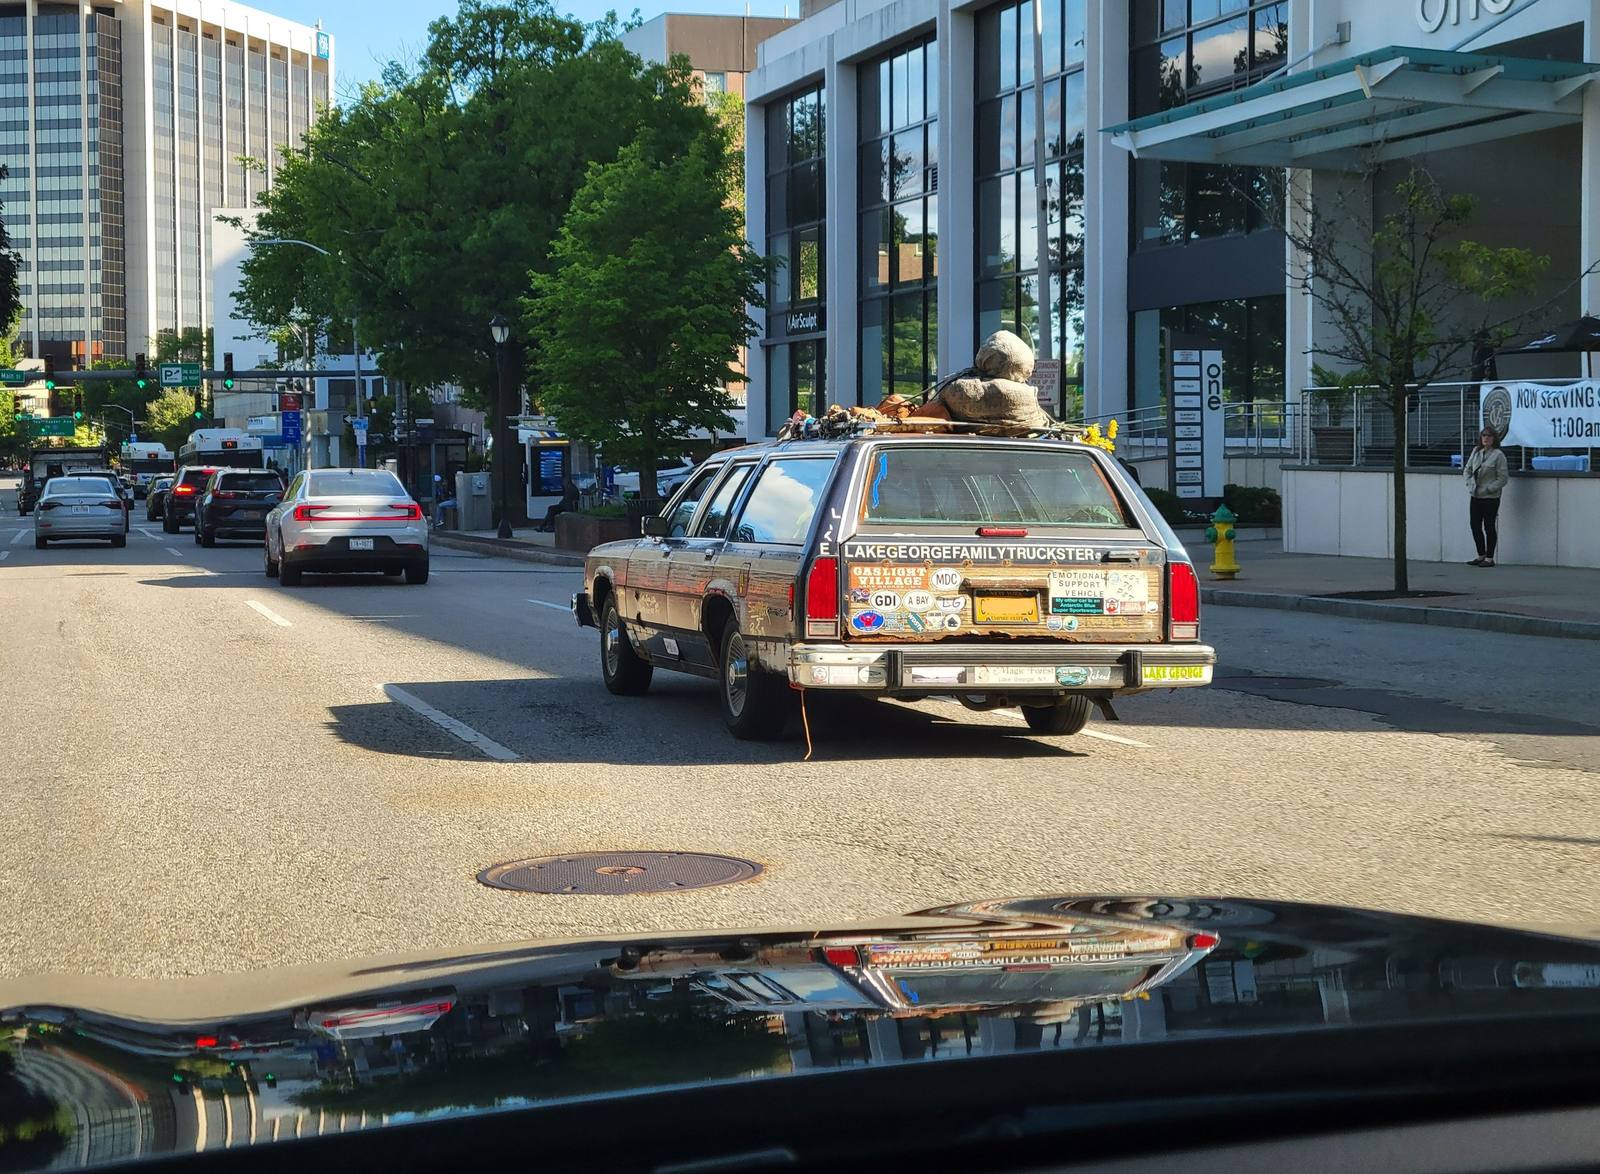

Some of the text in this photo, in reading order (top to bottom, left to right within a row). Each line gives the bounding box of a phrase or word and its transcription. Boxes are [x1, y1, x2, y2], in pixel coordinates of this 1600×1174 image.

[164, 370, 173, 381] P
[1206, 363, 1221, 411] one
[1517, 388, 1539, 409] NOW
[1540, 386, 1595, 409] SERVING
[844, 545, 1094, 561] LAKEGEORGEFAMILYTRUCKSTER
[853, 567, 927, 576] GASLIGHT
[1052, 572, 1104, 580] EMOTIONAL
[858, 576, 922, 586] VILLAGE
[936, 573, 957, 585] MDC
[1058, 580, 1100, 588] SUPPORT
[875, 595, 896, 607] GDI
[908, 596, 930, 606] A BAY
[1143, 666, 1203, 679] LAKE GEORGE
